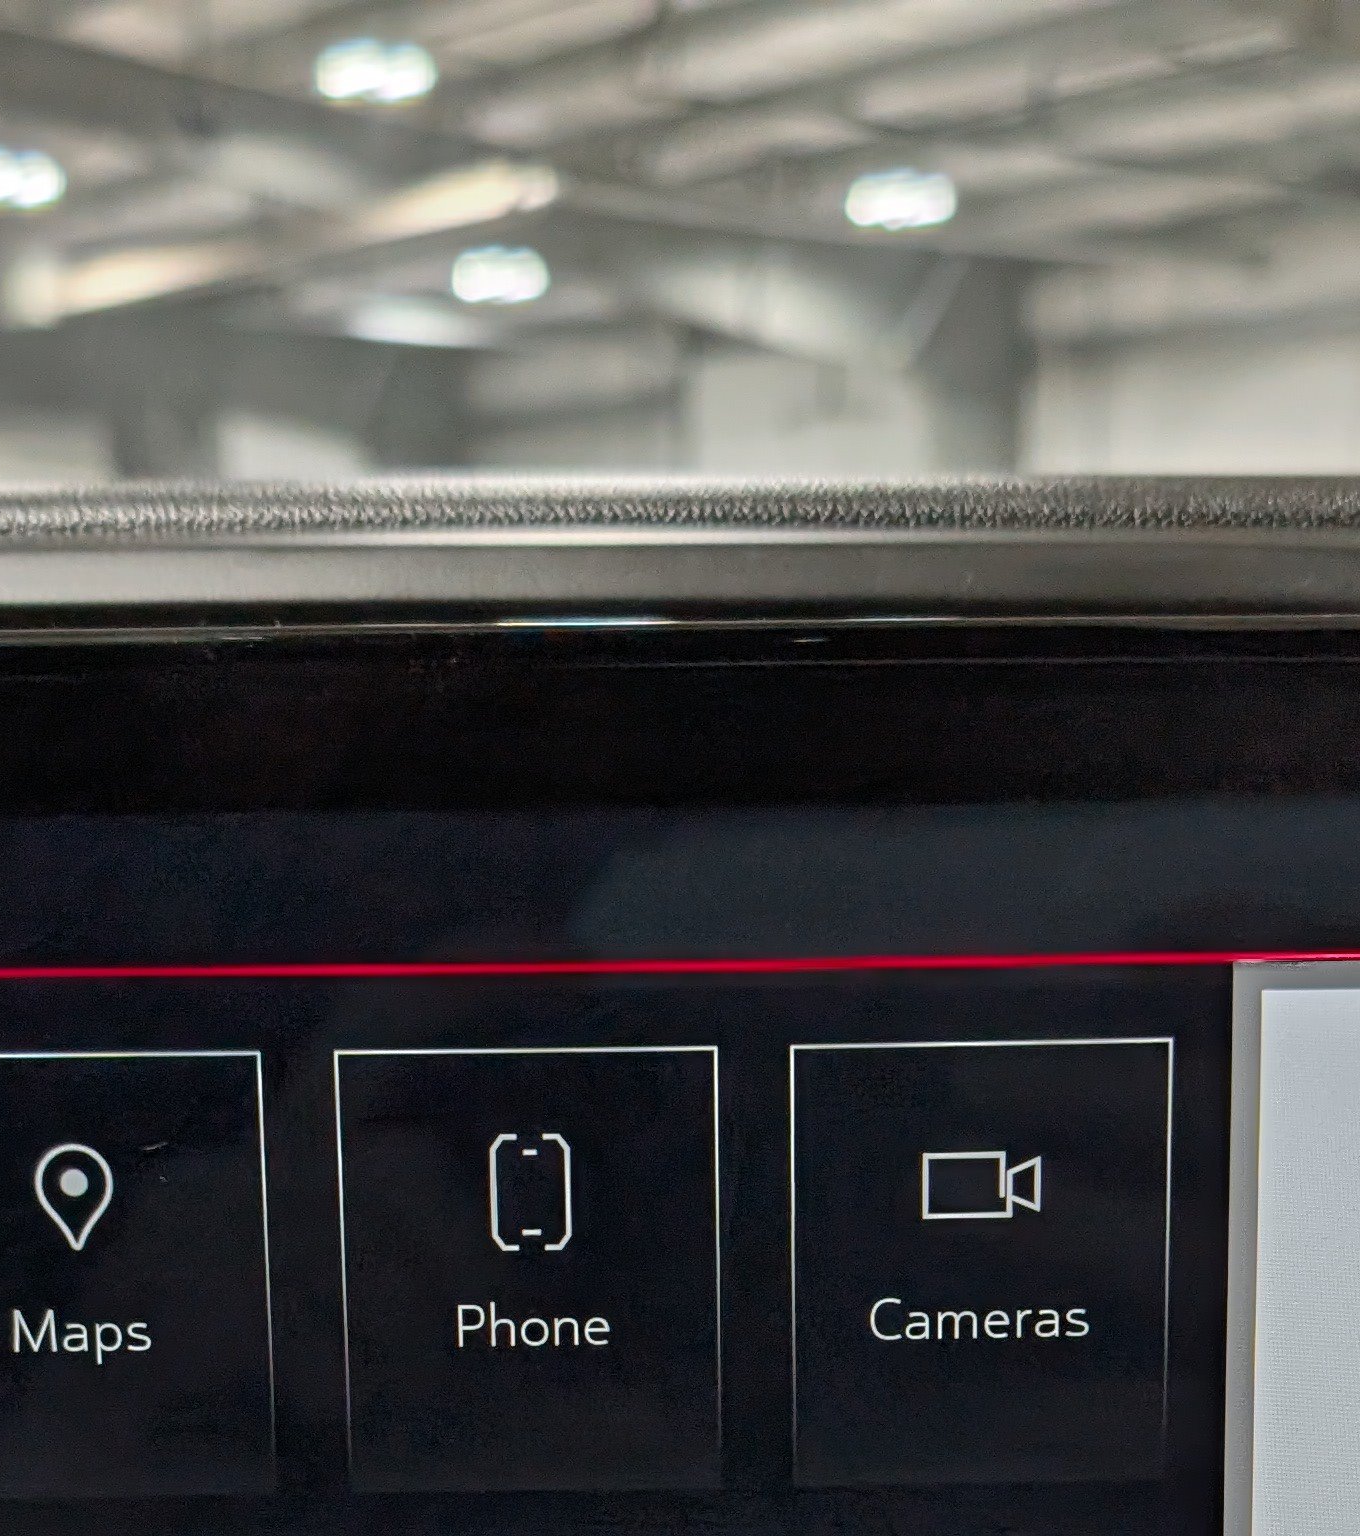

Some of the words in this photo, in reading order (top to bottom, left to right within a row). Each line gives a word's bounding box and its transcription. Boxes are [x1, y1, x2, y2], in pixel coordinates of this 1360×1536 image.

[13, 1309, 151, 1365] Maps
[458, 1302, 610, 1347] Phone
[870, 1298, 1089, 1340] Cameras
